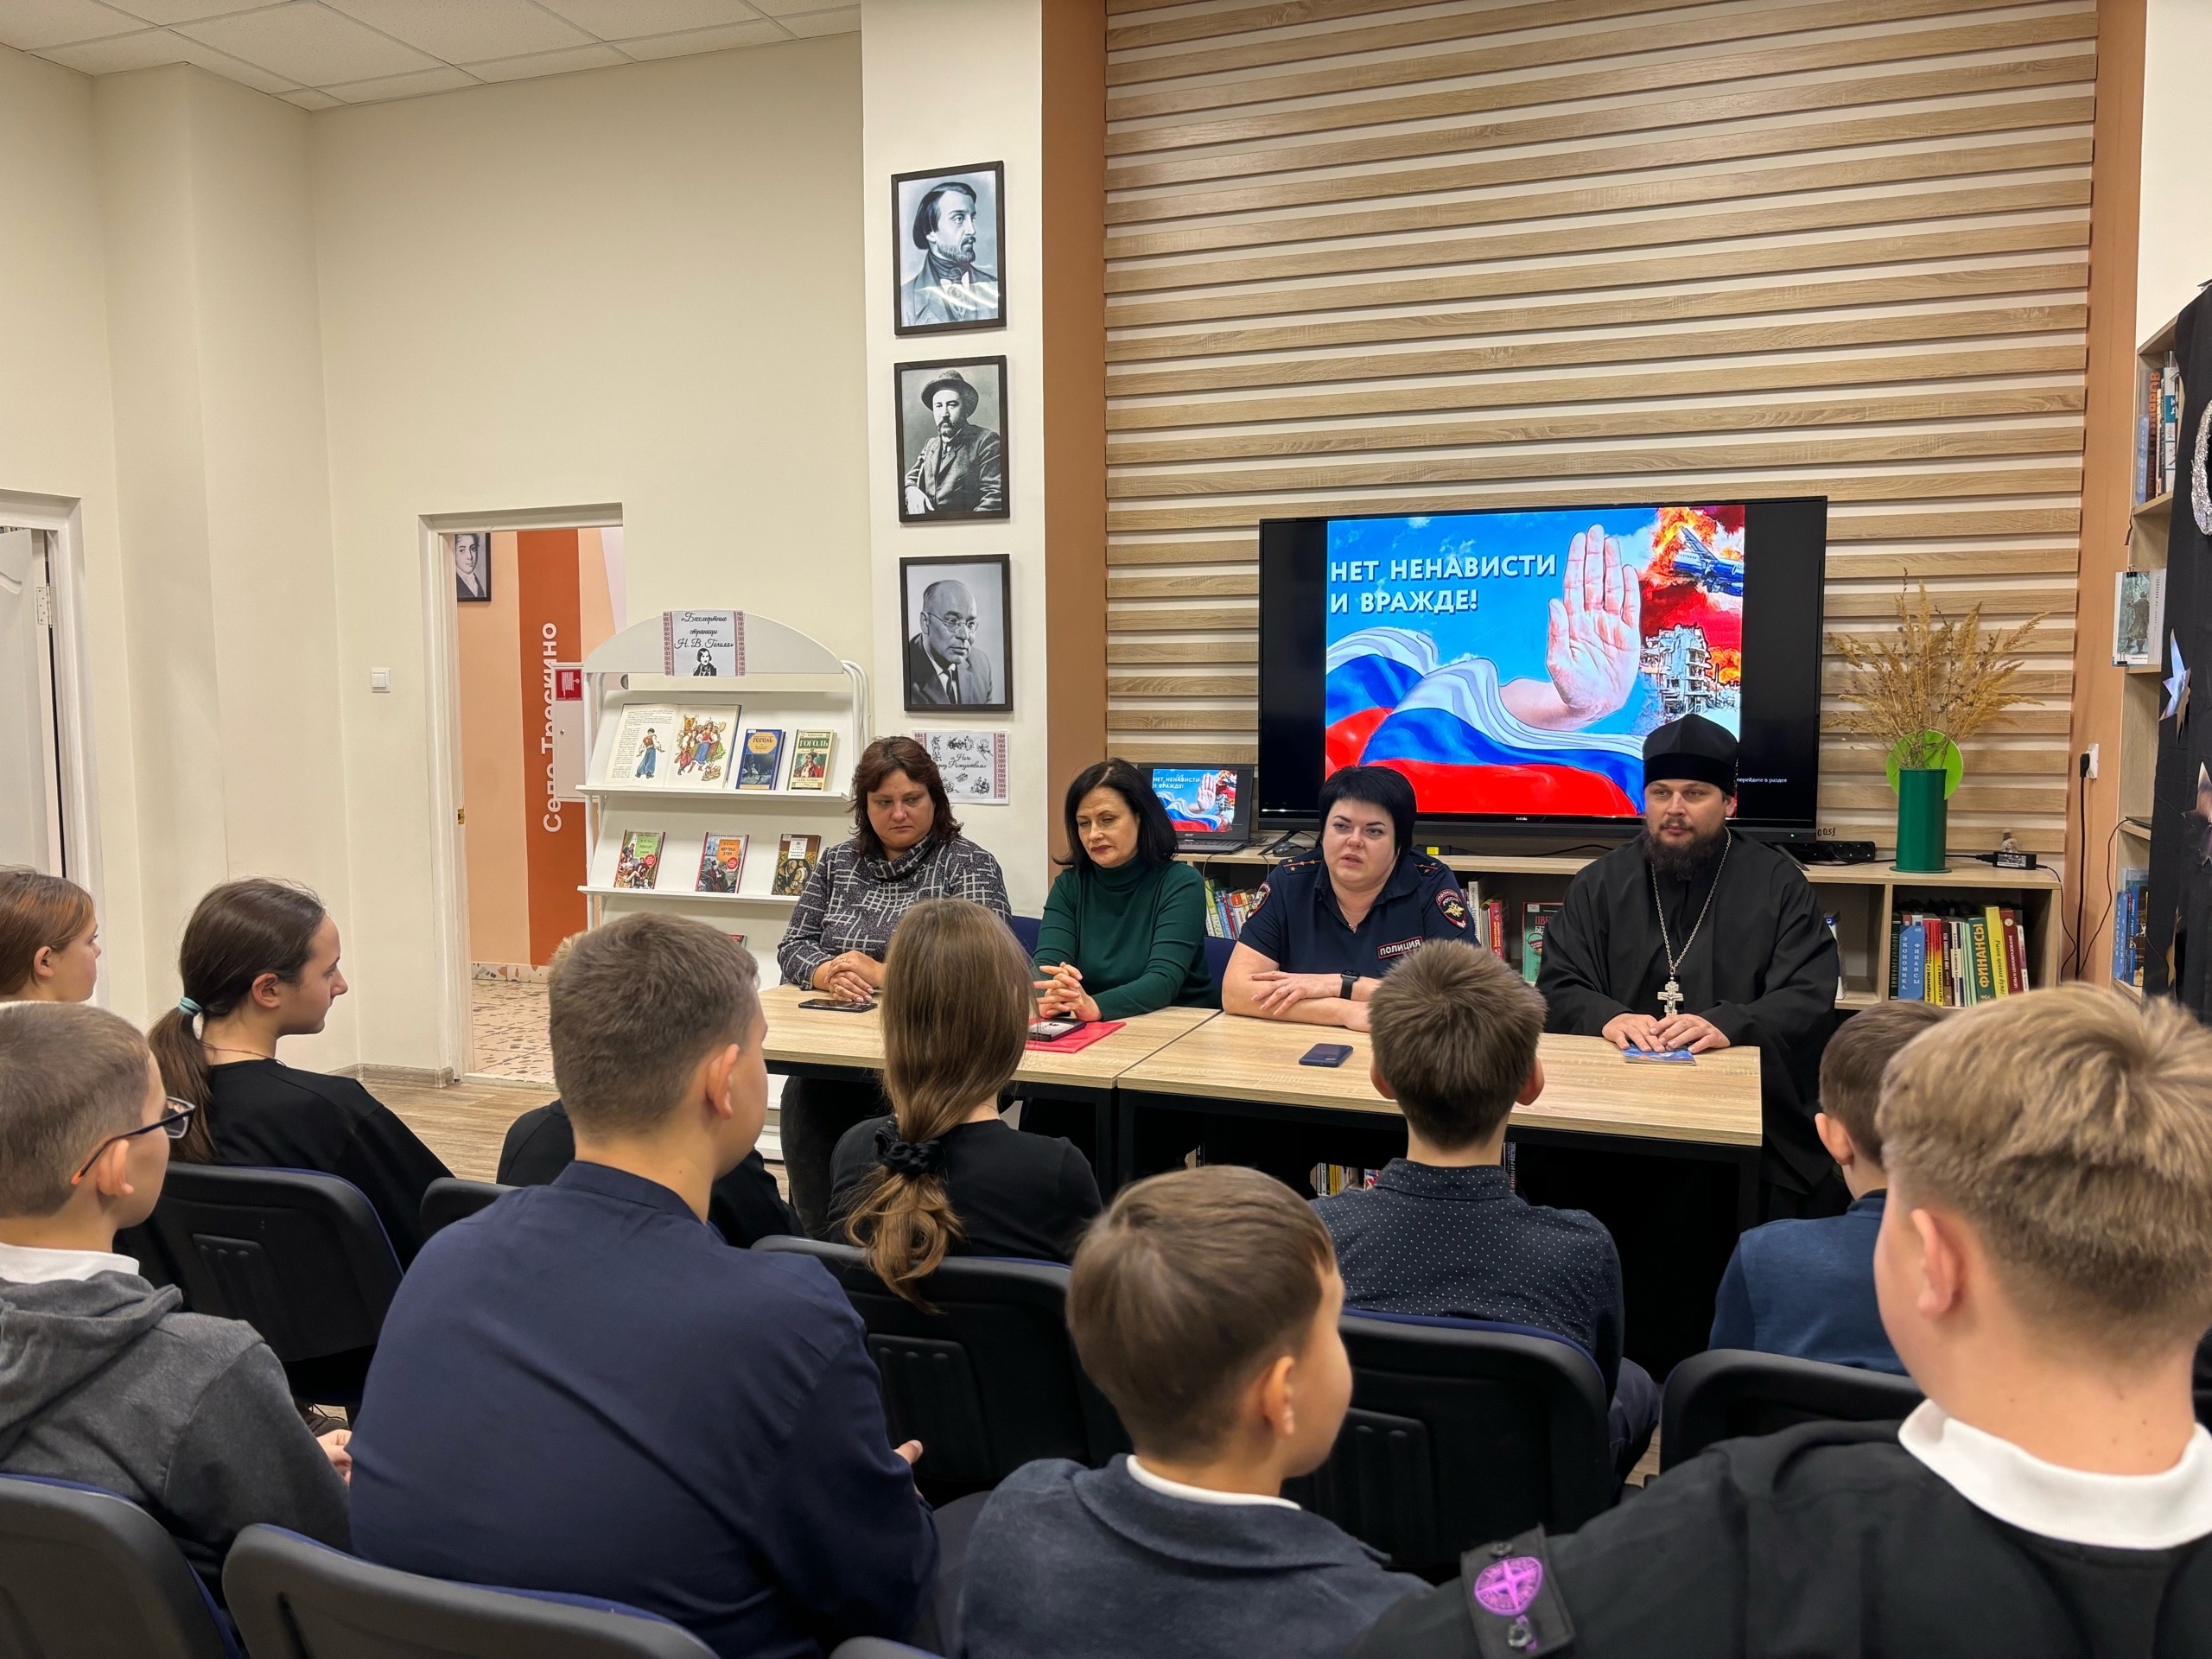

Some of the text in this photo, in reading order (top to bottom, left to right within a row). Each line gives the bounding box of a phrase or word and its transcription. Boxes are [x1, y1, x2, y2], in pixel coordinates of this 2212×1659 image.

[1331, 554, 1556, 582] НЕТ НЕНАВИСТИ
[1331, 588, 1478, 614] И ВРАЖДЕ!
[691, 639, 703, 648] В.
[799, 739, 829, 747] ГОГОЛЬ
[1380, 939, 1421, 956] ПОЛИЦИЯ
[1973, 923, 1990, 988] ФИНАНСЫ
